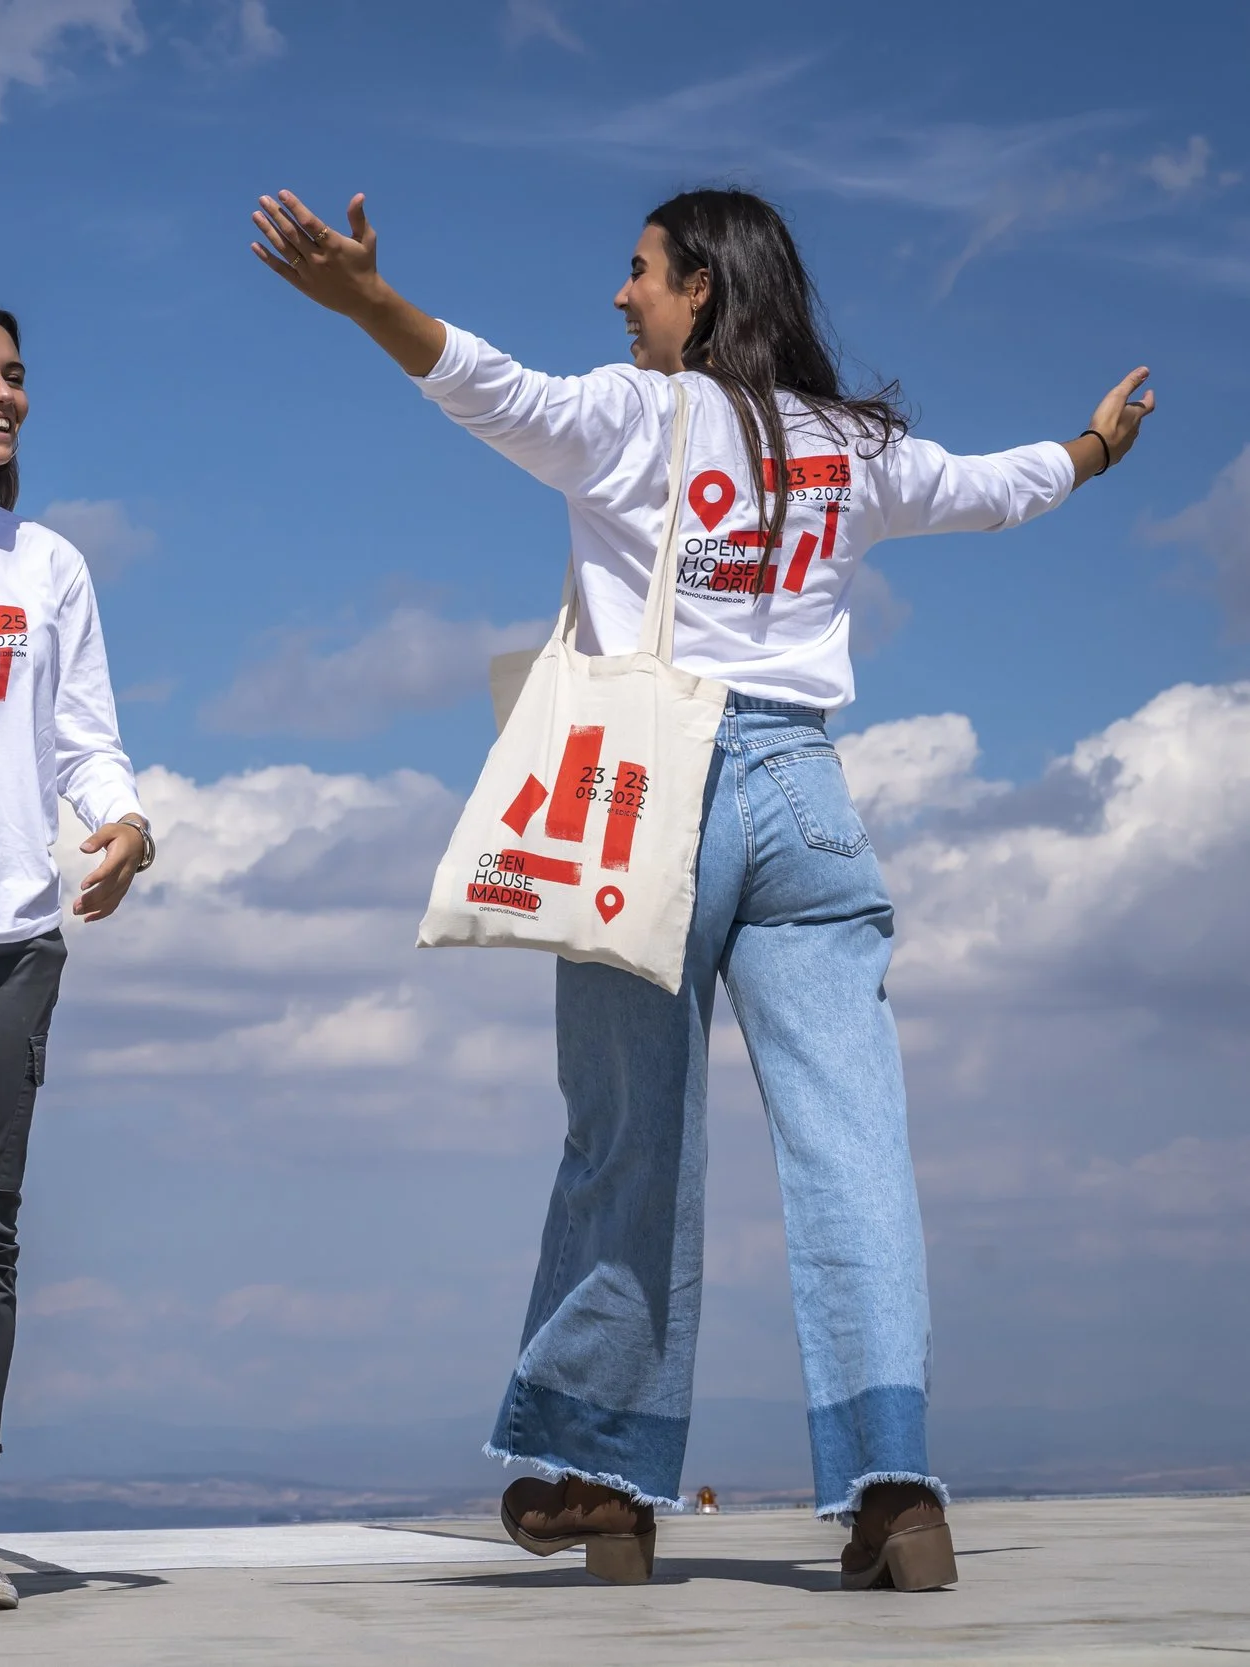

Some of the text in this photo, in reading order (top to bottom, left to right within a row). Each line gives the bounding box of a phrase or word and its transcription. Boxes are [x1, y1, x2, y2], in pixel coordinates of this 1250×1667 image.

[826, 464, 851, 483] 25
[684, 538, 747, 557] OPEN
[682, 556, 758, 577] HOUSE
[1, 614, 27, 630] 25
[580, 766, 606, 784] 23
[625, 771, 650, 793] 25
[575, 786, 646, 810] 09.2022
[478, 853, 525, 873] OPEN
[474, 869, 534, 892] HOUSE
[471, 886, 542, 911] MADRID
